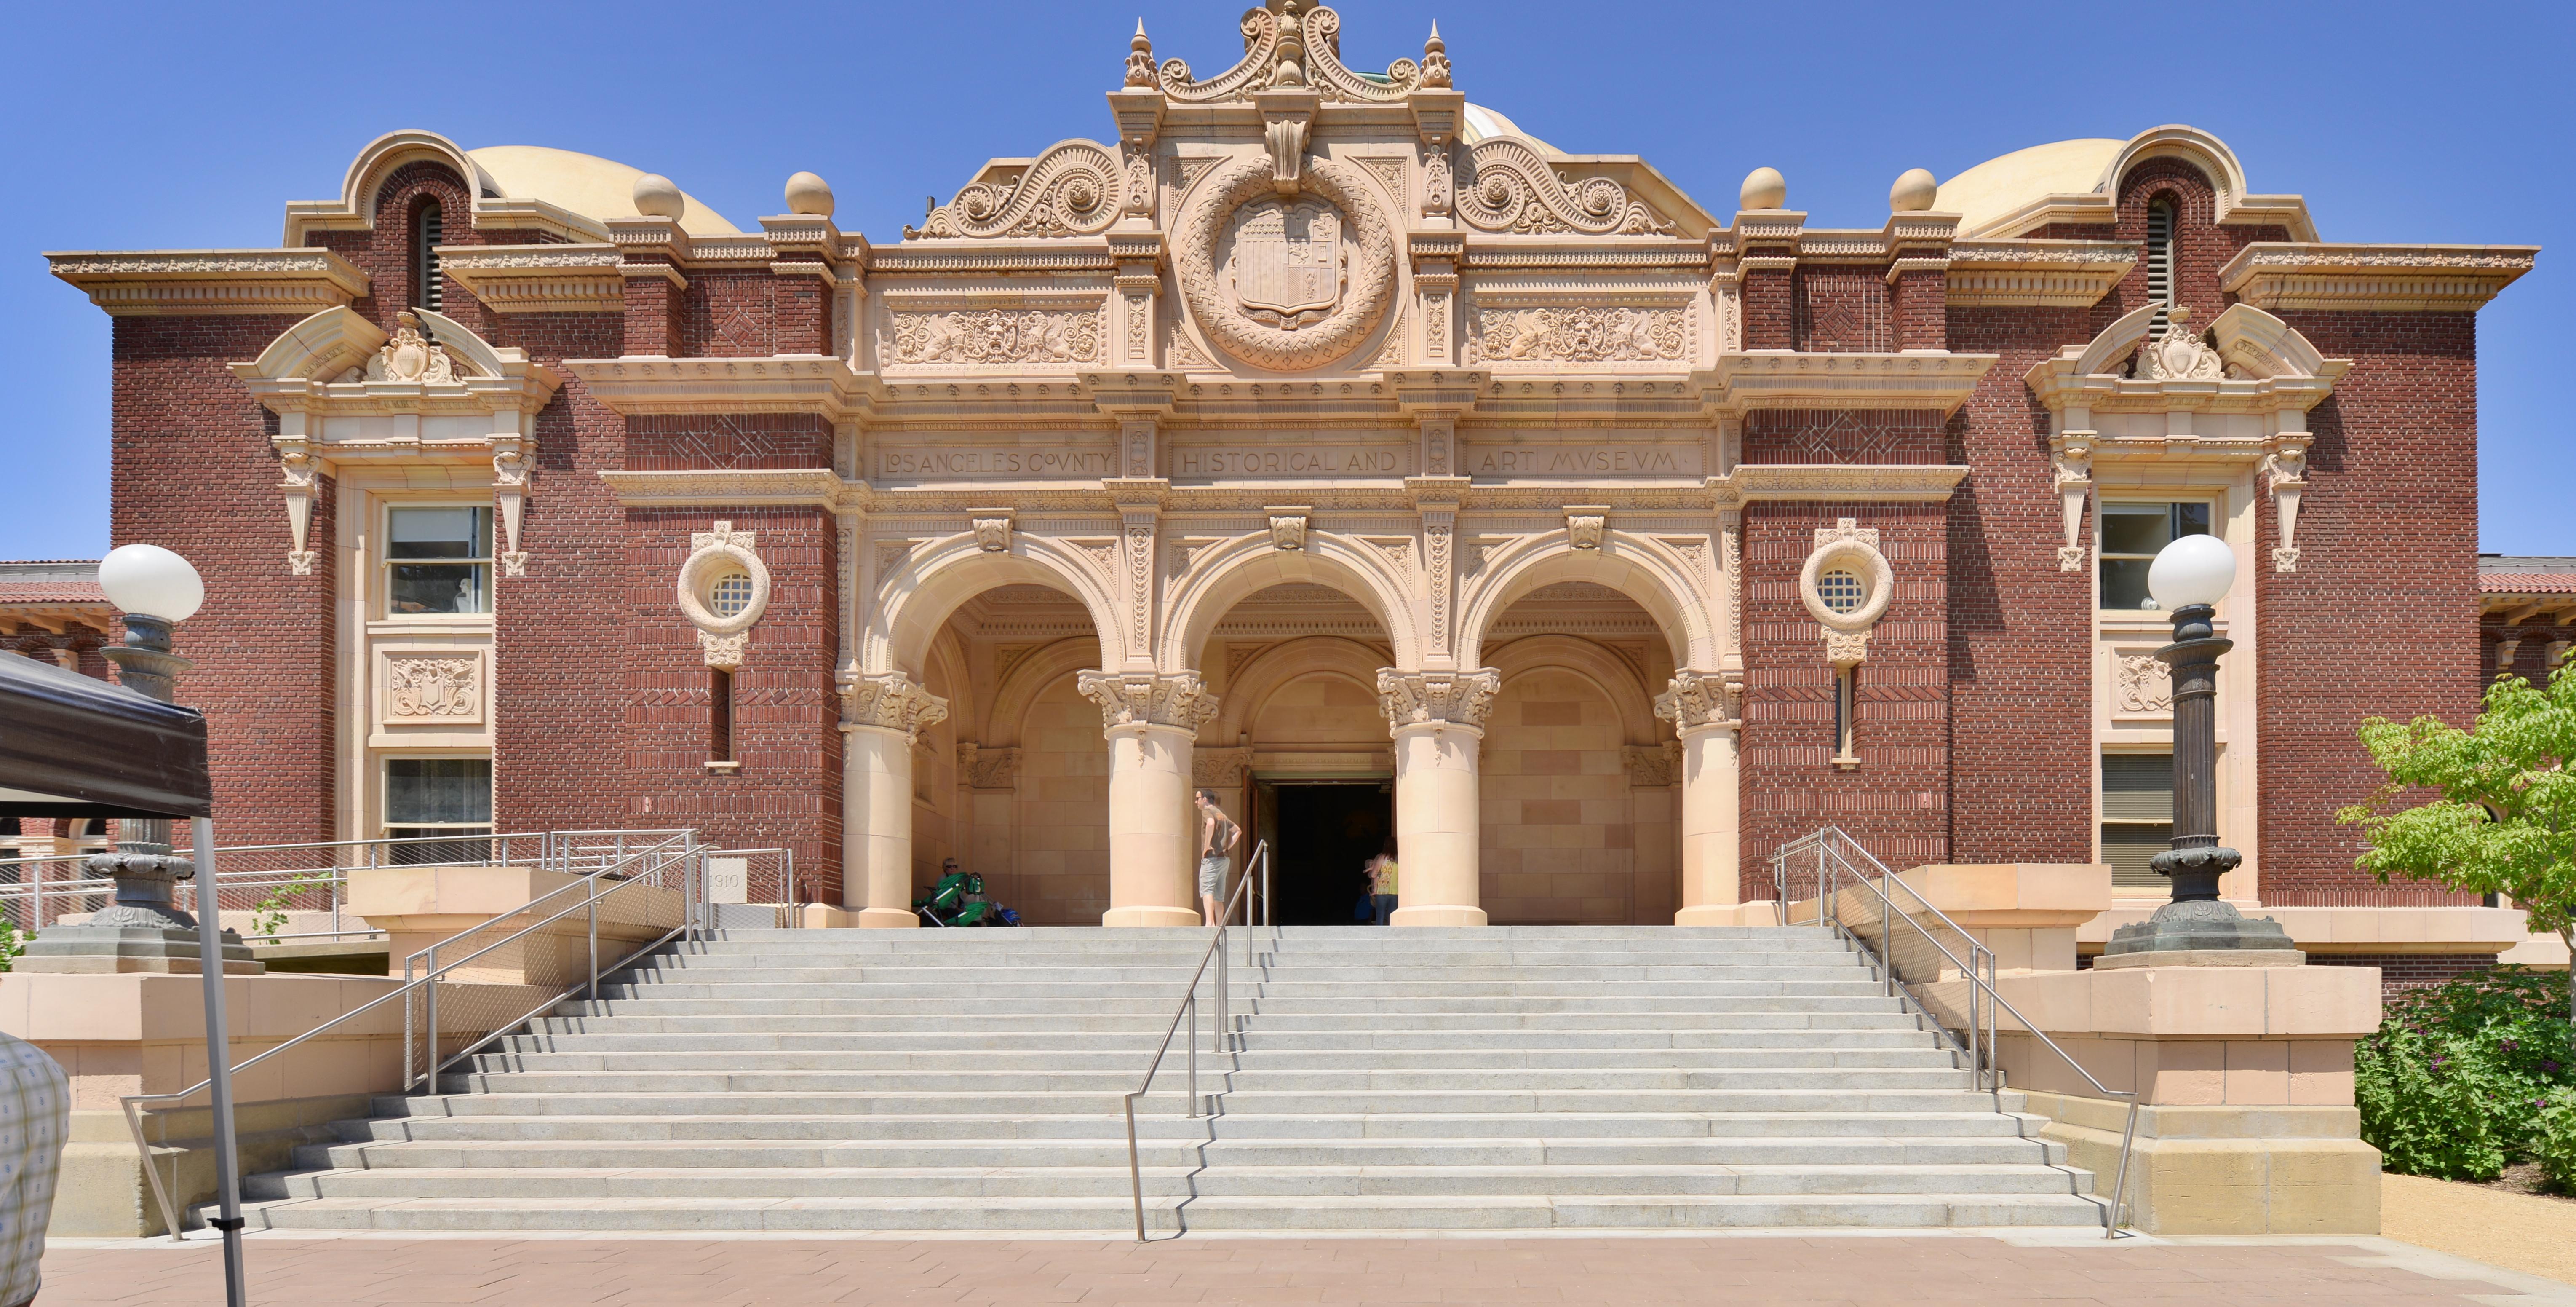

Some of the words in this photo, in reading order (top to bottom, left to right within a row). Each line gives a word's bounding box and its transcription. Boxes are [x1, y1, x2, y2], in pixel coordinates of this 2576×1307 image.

[919, 453, 1020, 473] ANGELES
[1183, 452, 1336, 472] HISTORICAL
[1347, 452, 1396, 471] AND
[1481, 452, 1534, 470] ART
[1549, 451, 1678, 470] MVSEVM
[709, 874, 738, 887] 1910
